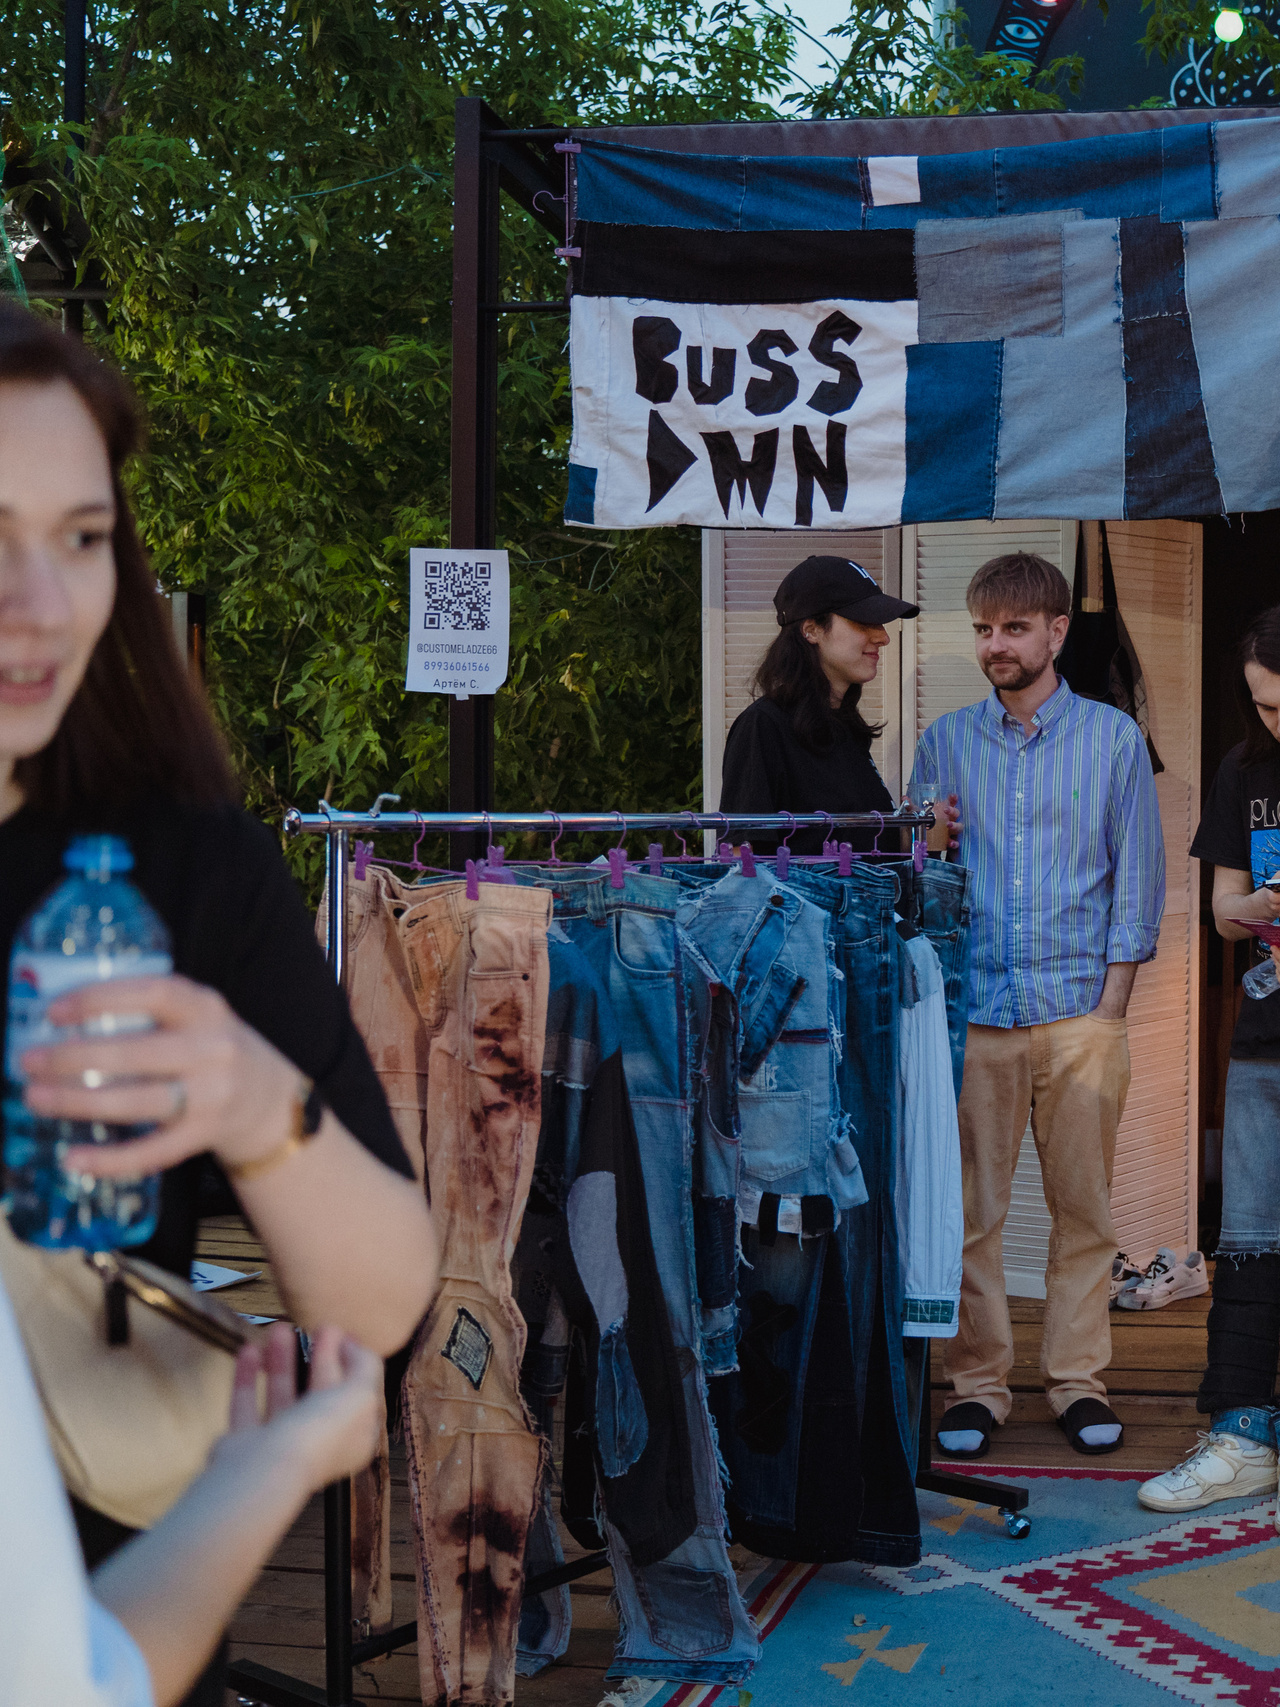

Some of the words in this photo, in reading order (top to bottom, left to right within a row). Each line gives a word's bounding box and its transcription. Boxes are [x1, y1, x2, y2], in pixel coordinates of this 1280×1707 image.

[416, 643, 498, 655] @CUSTOMELADZE66
[423, 661, 490, 672] 89936061566
[433, 678, 466, 690] Артём
[469, 680, 480, 689] С.
